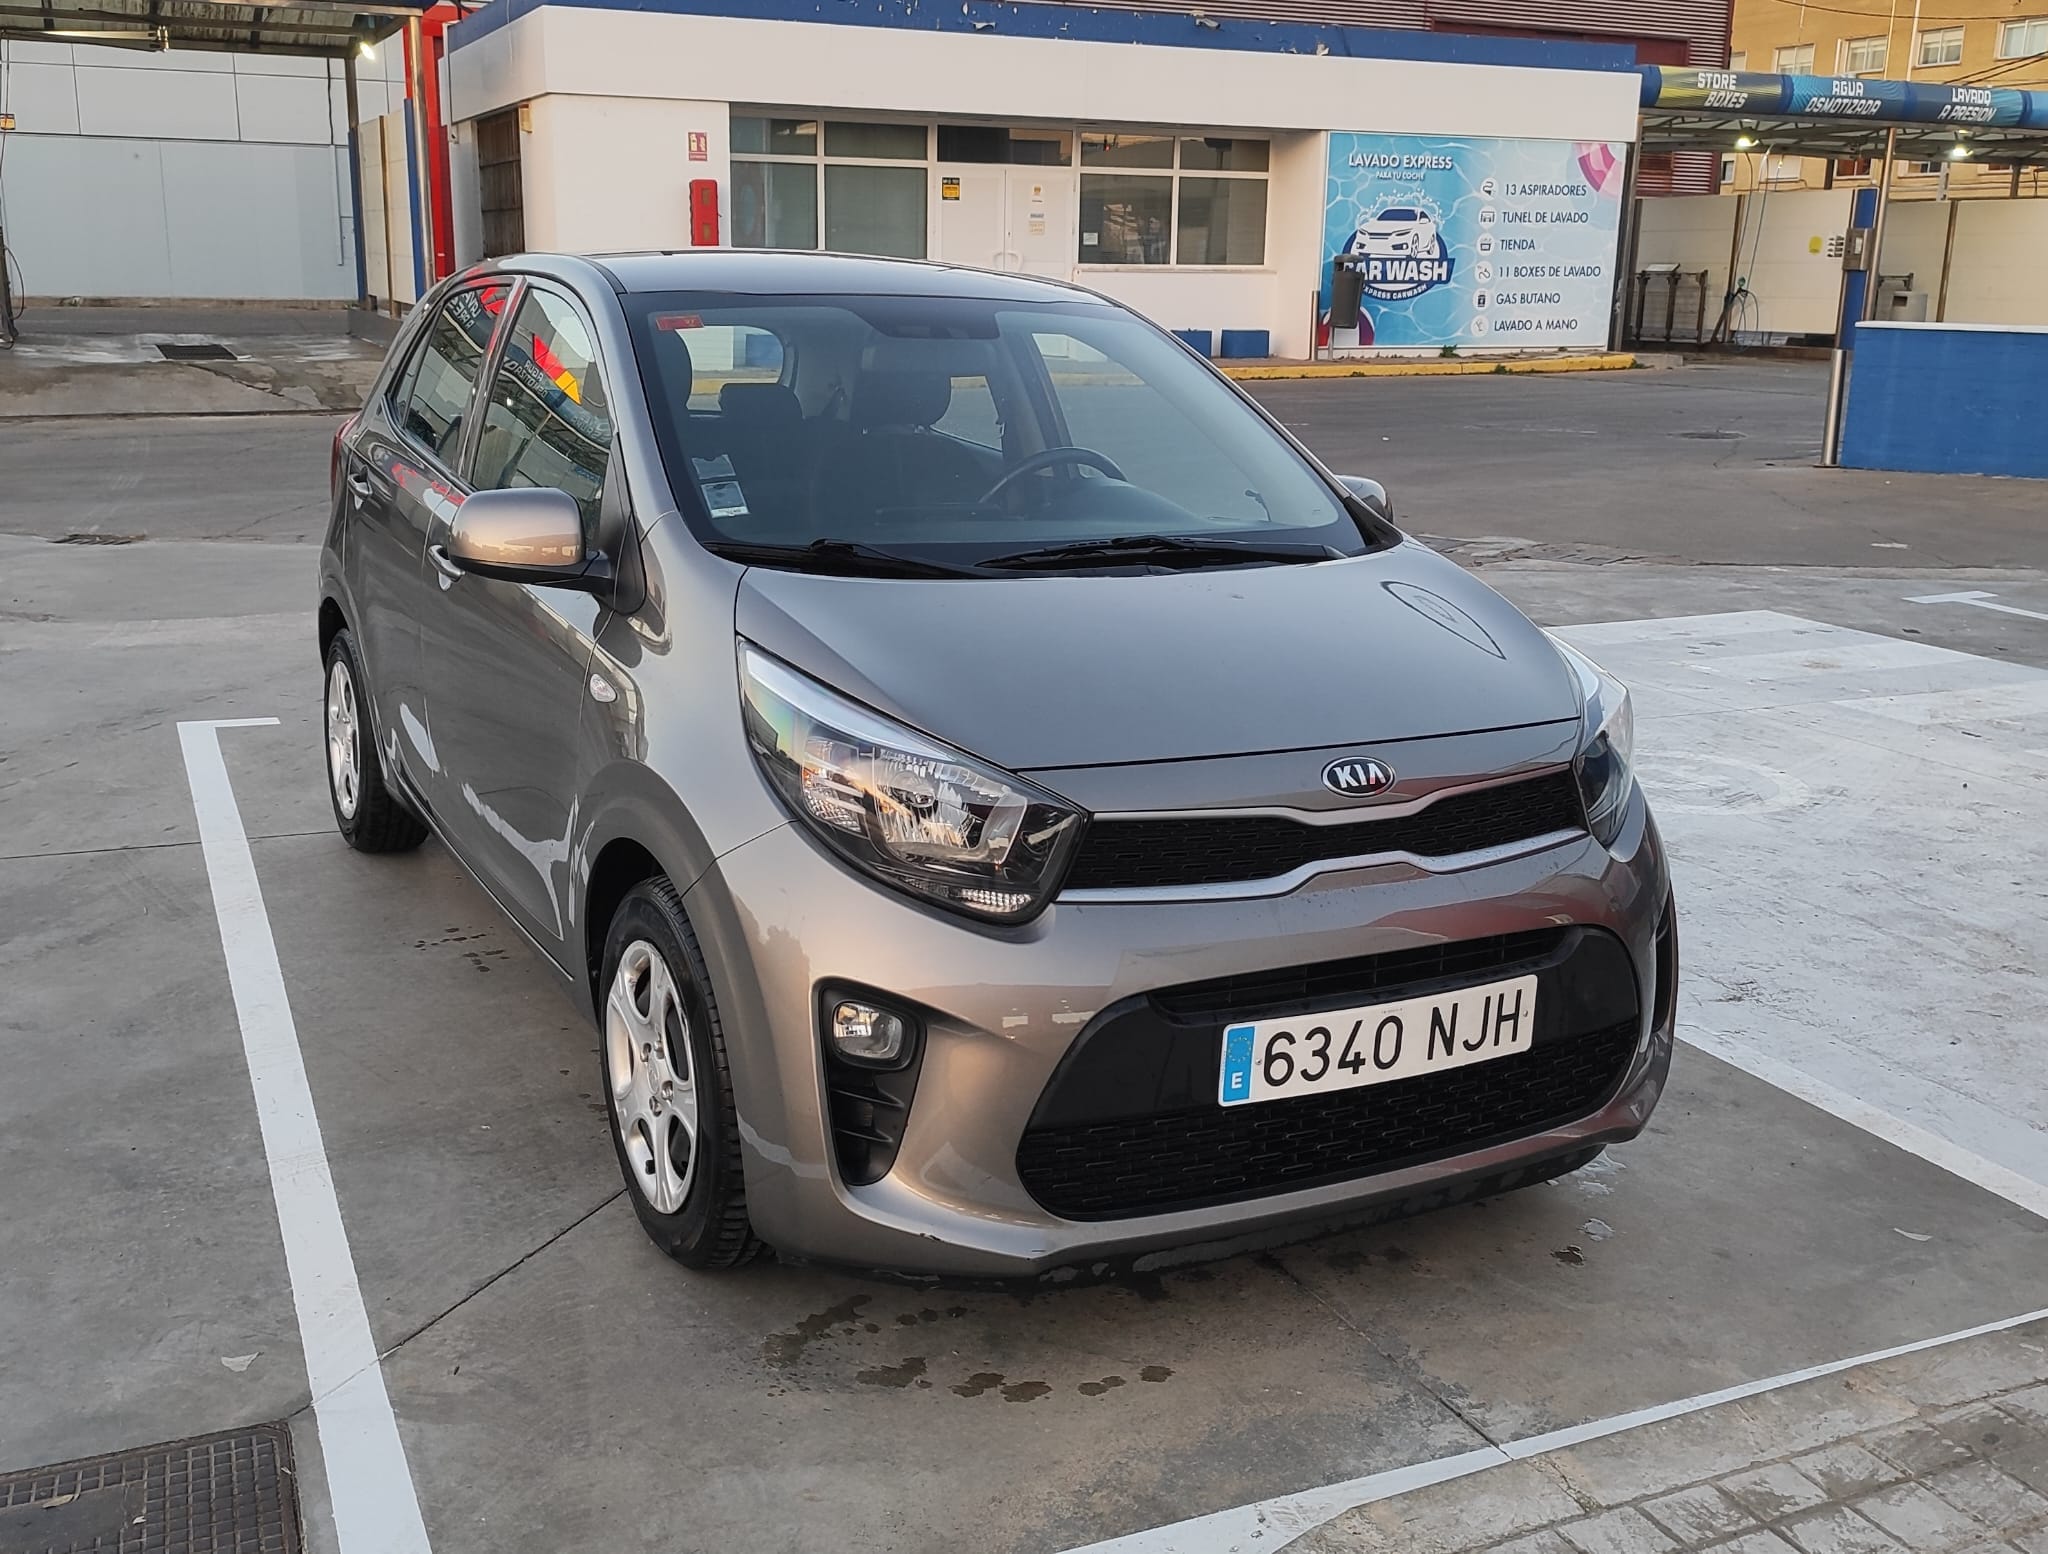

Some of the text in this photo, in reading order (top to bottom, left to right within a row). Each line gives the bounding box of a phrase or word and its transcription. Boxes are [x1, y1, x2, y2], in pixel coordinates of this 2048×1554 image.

[1697, 73, 1737, 89] STORE
[1832, 80, 1864, 96] AGUA
[1704, 91, 1748, 108] BOXES
[1952, 88, 1991, 106] LAVADO
[1805, 97, 1881, 115] OSMOTIZADA
[1937, 104, 1997, 122] A PRESION
[1348, 153, 1453, 169] LAVADO EXPRESS
[1393, 172, 1402, 180] TU
[1505, 183, 1587, 196] 13 ASPIRADORES
[1502, 211, 1589, 223] TUNEL DE LAVADO
[1500, 239, 1535, 250] TIENDA
[1385, 260, 1448, 281] WASH
[1499, 266, 1601, 278] 11 BOXES DE LAVADO
[1362, 284, 1427, 299] XPRESS CARWASH
[1496, 293, 1561, 304] GAS BUTANO
[1494, 319, 1578, 332] LAVADO A MANO
[1333, 763, 1386, 789] KIA
[1263, 989, 1522, 1087] 6340 NJH
[1230, 1072, 1243, 1089] E
